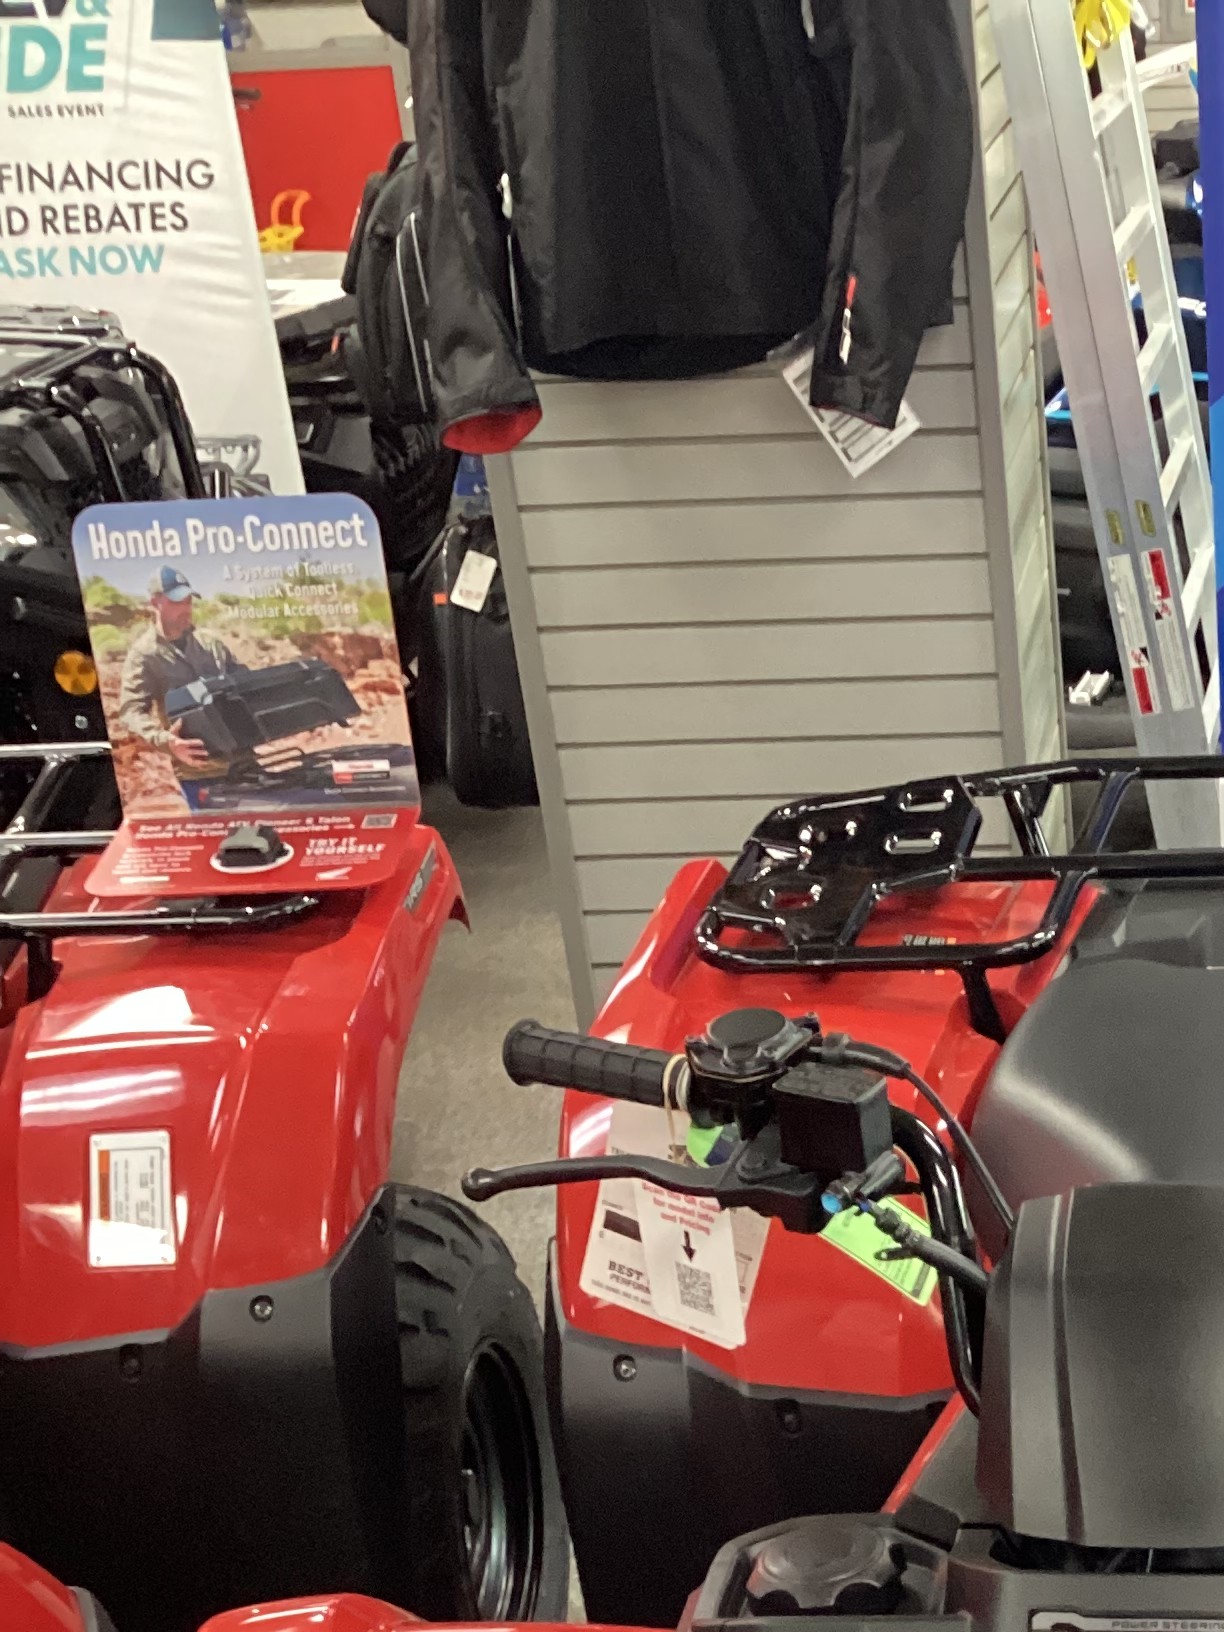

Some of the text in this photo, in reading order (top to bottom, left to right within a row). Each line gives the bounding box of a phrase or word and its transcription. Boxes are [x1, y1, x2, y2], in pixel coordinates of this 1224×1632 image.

[0, 23, 108, 93] DE
[8, 103, 104, 118] SALES EVENT
[0, 158, 215, 194] FINANCING
[0, 201, 189, 237] D REBATES
[68, 244, 165, 275] NOW
[88, 512, 369, 560] Honda Pro-Connect
[286, 561, 300, 578] of
[284, 582, 338, 598] Connect
[227, 602, 359, 619] Modular Accessories
[609, 1260, 643, 1281] BEST
[1110, 1620, 1159, 1630] POWER
